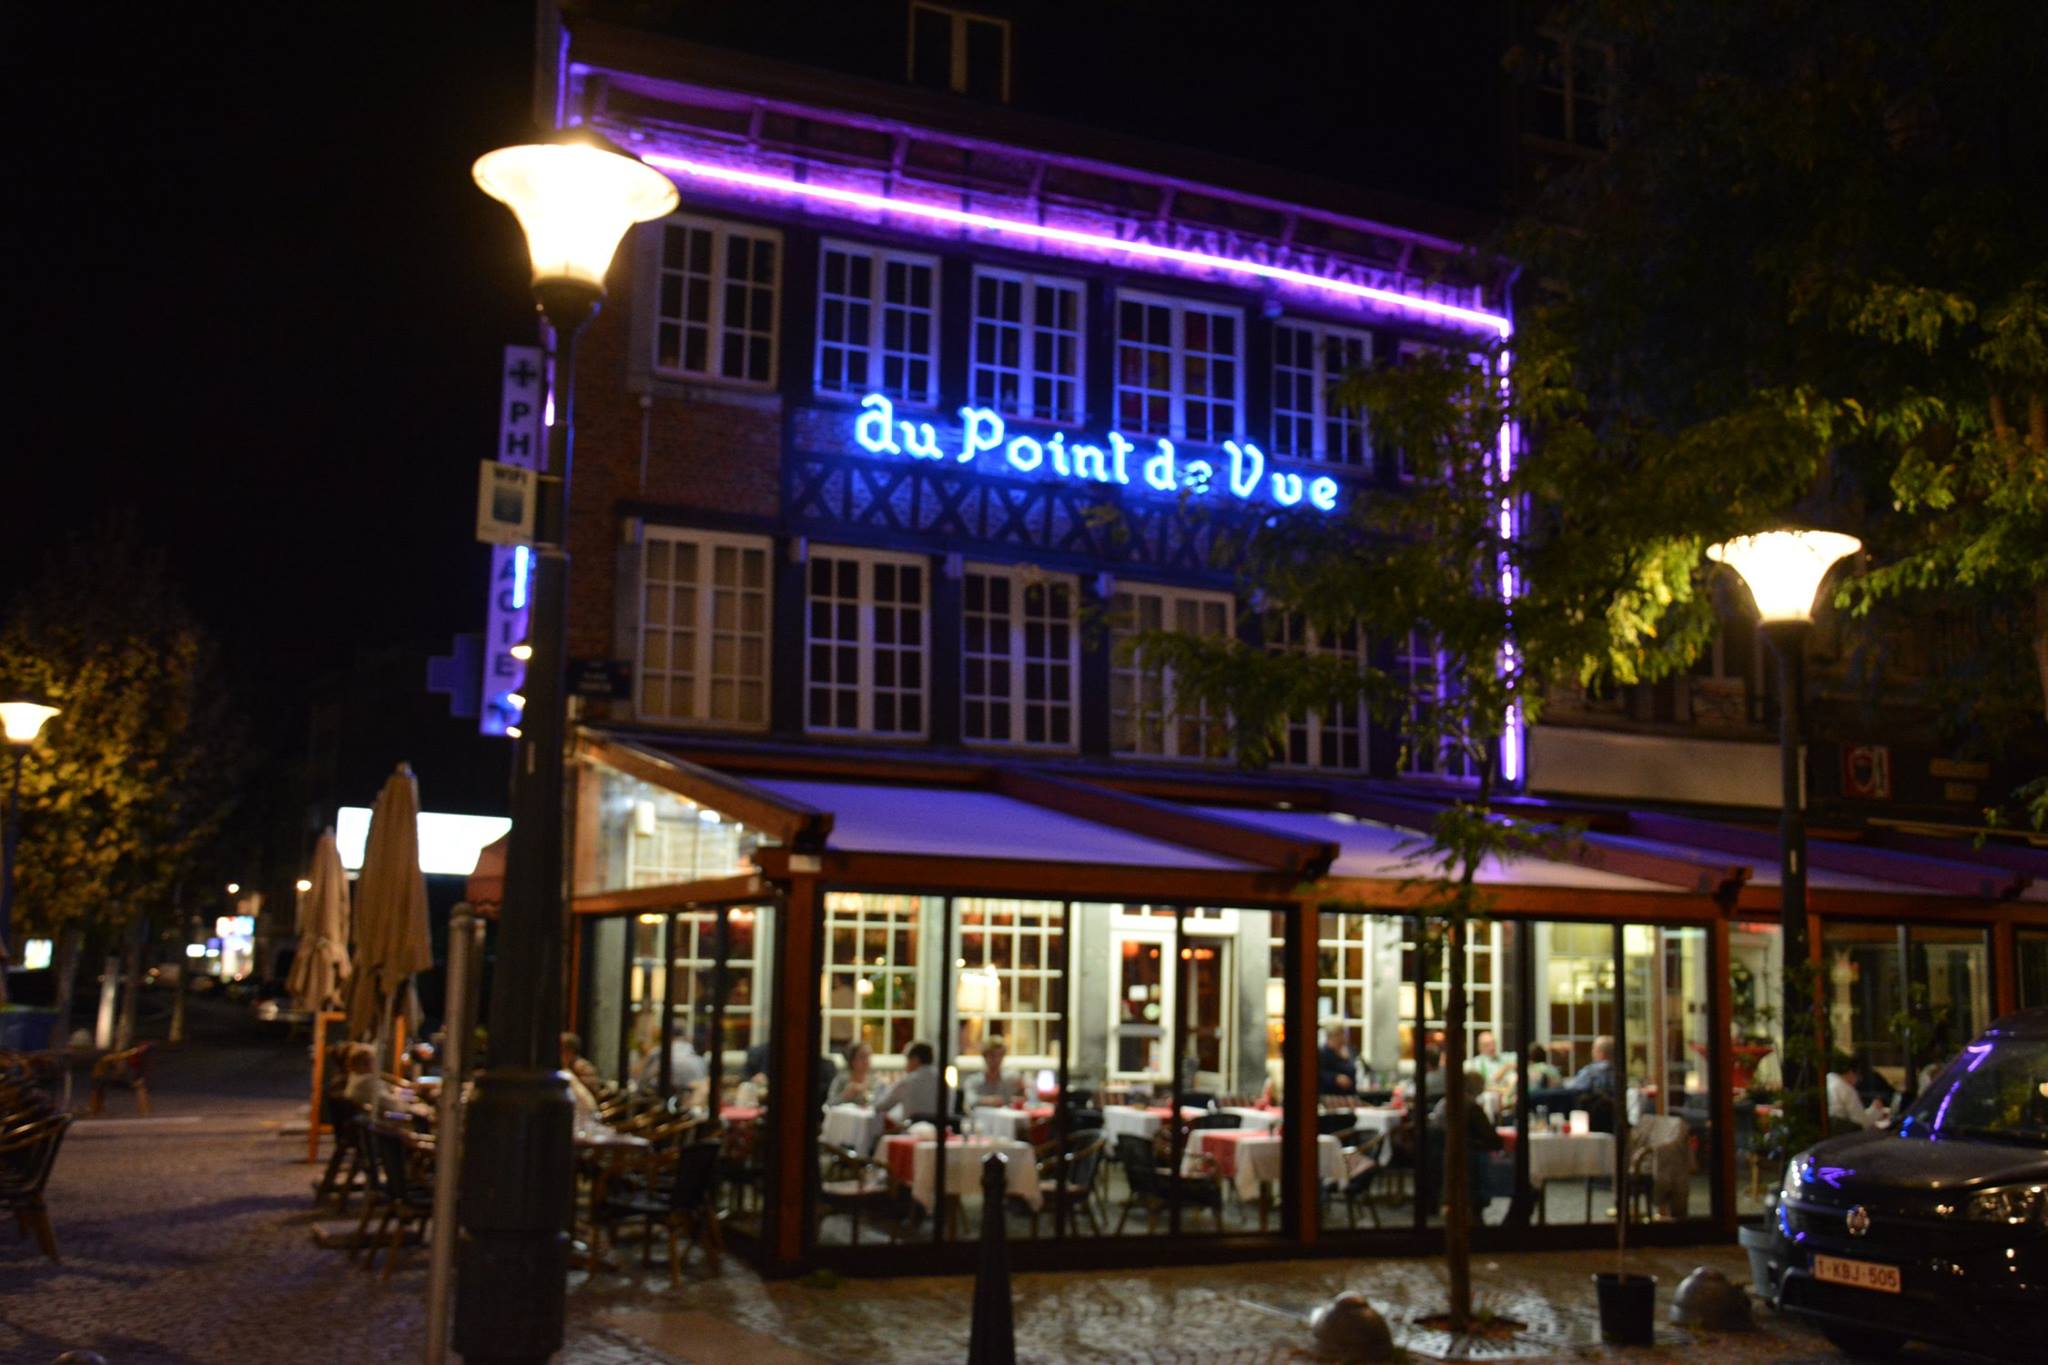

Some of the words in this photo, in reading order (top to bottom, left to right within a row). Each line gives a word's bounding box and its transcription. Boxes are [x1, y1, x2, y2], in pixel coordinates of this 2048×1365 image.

[956, 406, 1135, 485] Point
[1143, 437, 1214, 494] de
[1223, 440, 1339, 511] Vue
